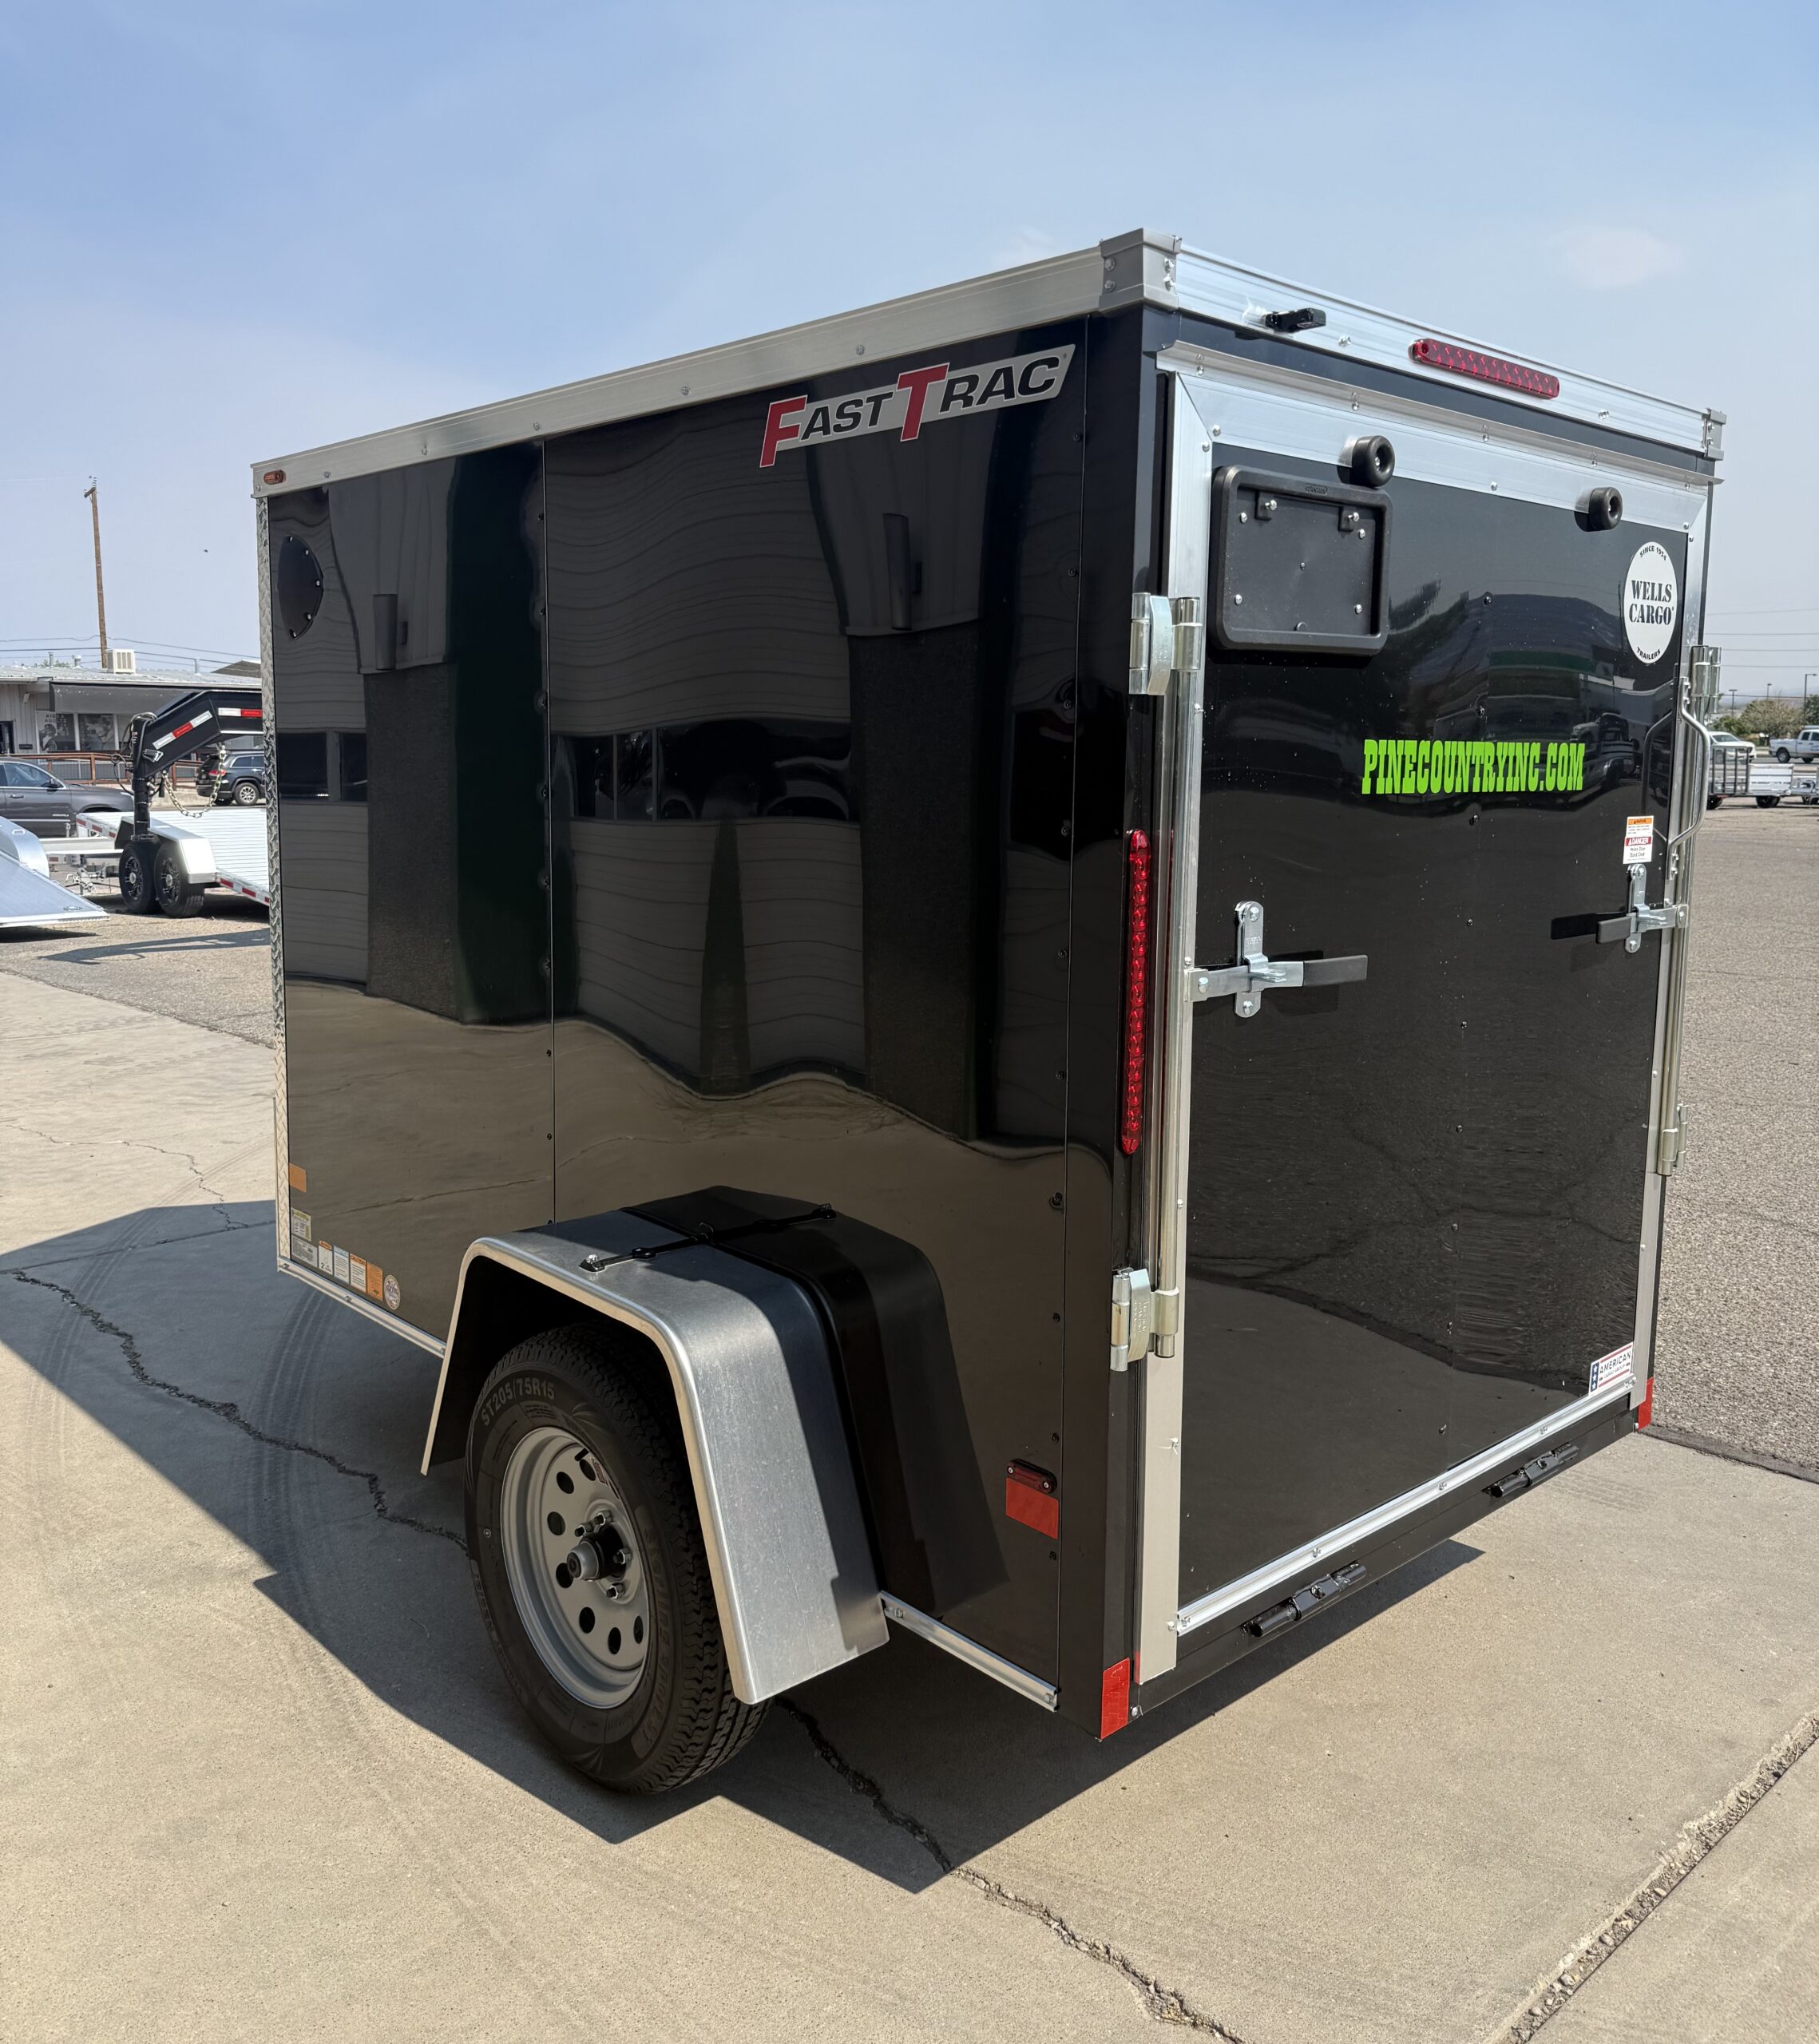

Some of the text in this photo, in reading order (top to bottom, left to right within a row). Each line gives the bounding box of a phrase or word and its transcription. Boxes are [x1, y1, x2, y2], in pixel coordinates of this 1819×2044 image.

[1639, 545, 1655, 558] SINCE
[1631, 580, 1672, 603] WELLS
[1628, 604, 1672, 625] CARGO
[1637, 647, 1661, 660] TRAILERS
[1361, 739, 1583, 794] PINECOUNTRYINC.COM
[1599, 1350, 1631, 1374] AMERICAN
[481, 1377, 555, 1427] ST205/75R15
